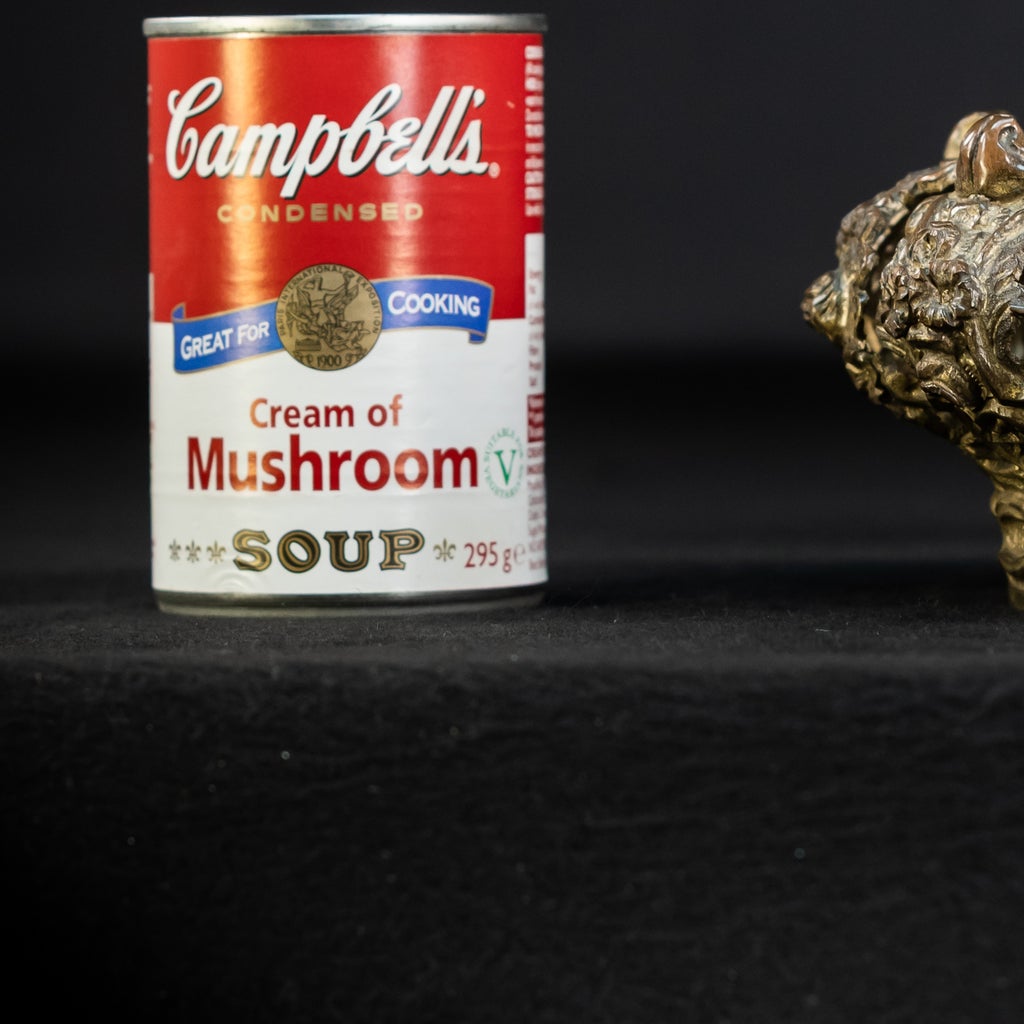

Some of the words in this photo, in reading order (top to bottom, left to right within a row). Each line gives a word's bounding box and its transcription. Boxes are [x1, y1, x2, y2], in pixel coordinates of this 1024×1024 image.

[165, 75, 488, 198] Campbell's
[217, 203, 424, 222] CONDENSED
[318, 356, 341, 367] 1900
[250, 397, 354, 428] Cream
[368, 394, 402, 427] of
[187, 434, 479, 492] Mushroom
[232, 528, 426, 574] SOUP
[464, 543, 499, 568] 295
